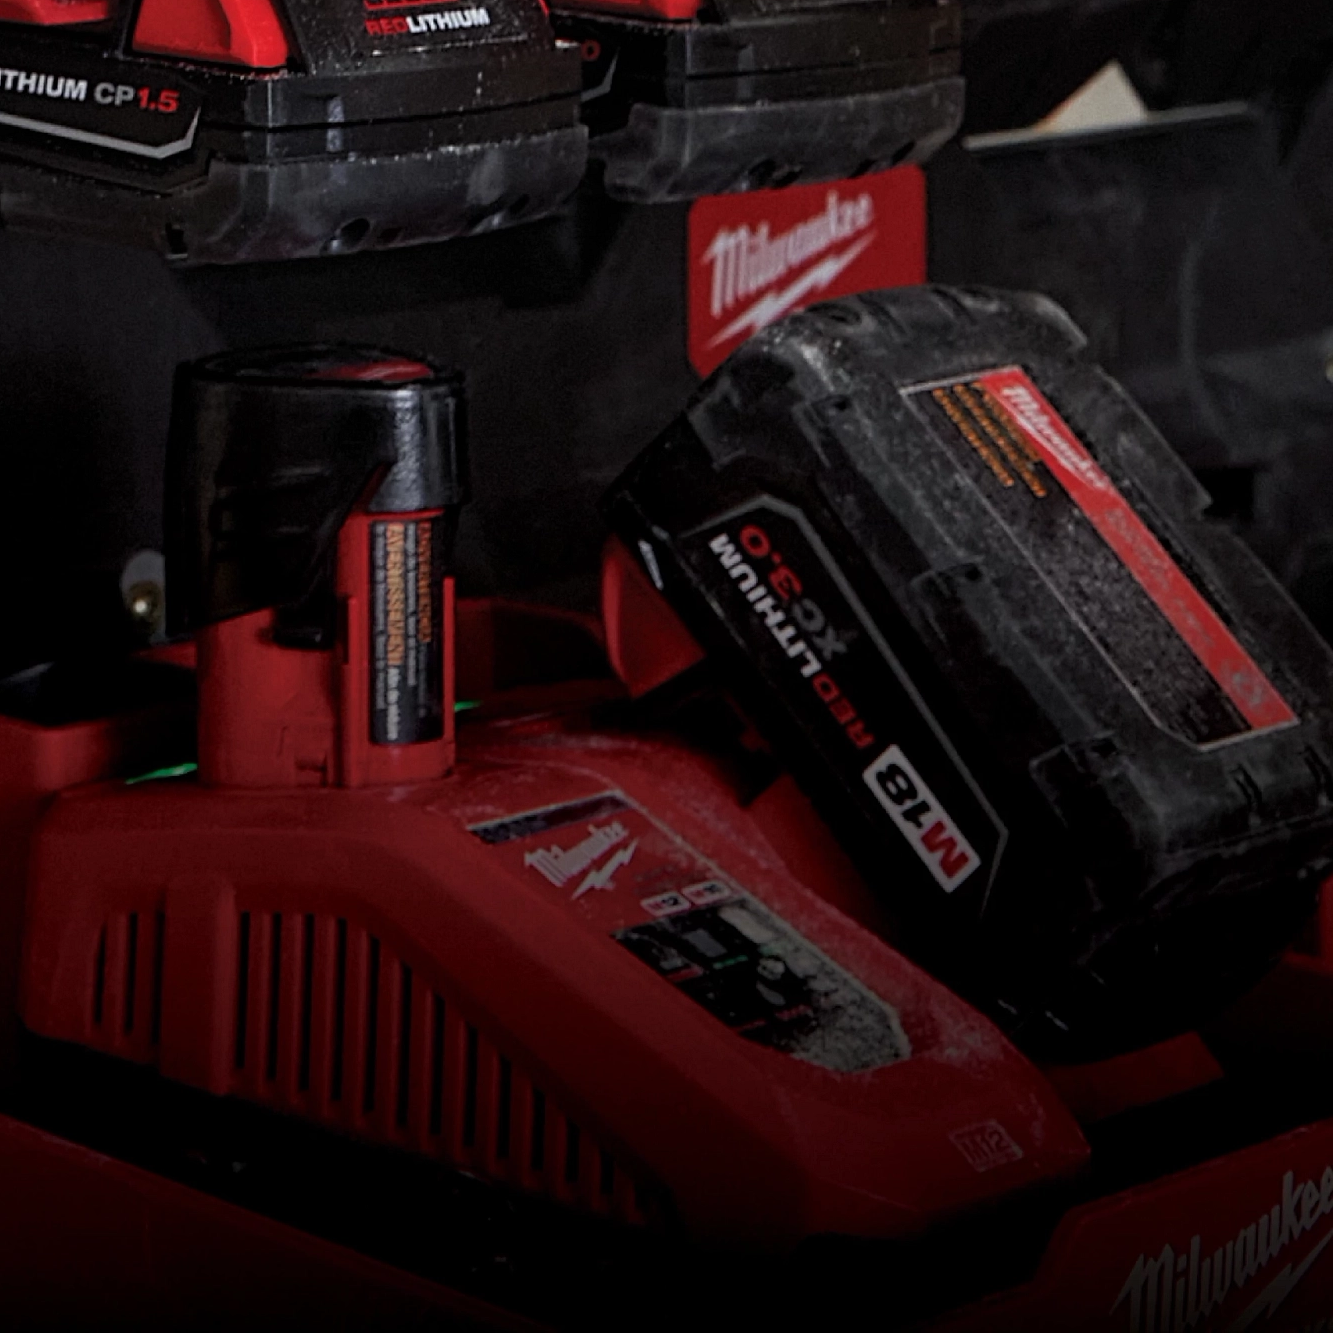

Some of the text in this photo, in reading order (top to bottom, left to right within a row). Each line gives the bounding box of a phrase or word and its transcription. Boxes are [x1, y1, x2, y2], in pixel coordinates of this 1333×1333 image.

[365, 7, 490, 36] REDLITHIUM
[739, 525, 844, 656] XC3.0
[707, 528, 974, 882] M18 REDLITHIUM
